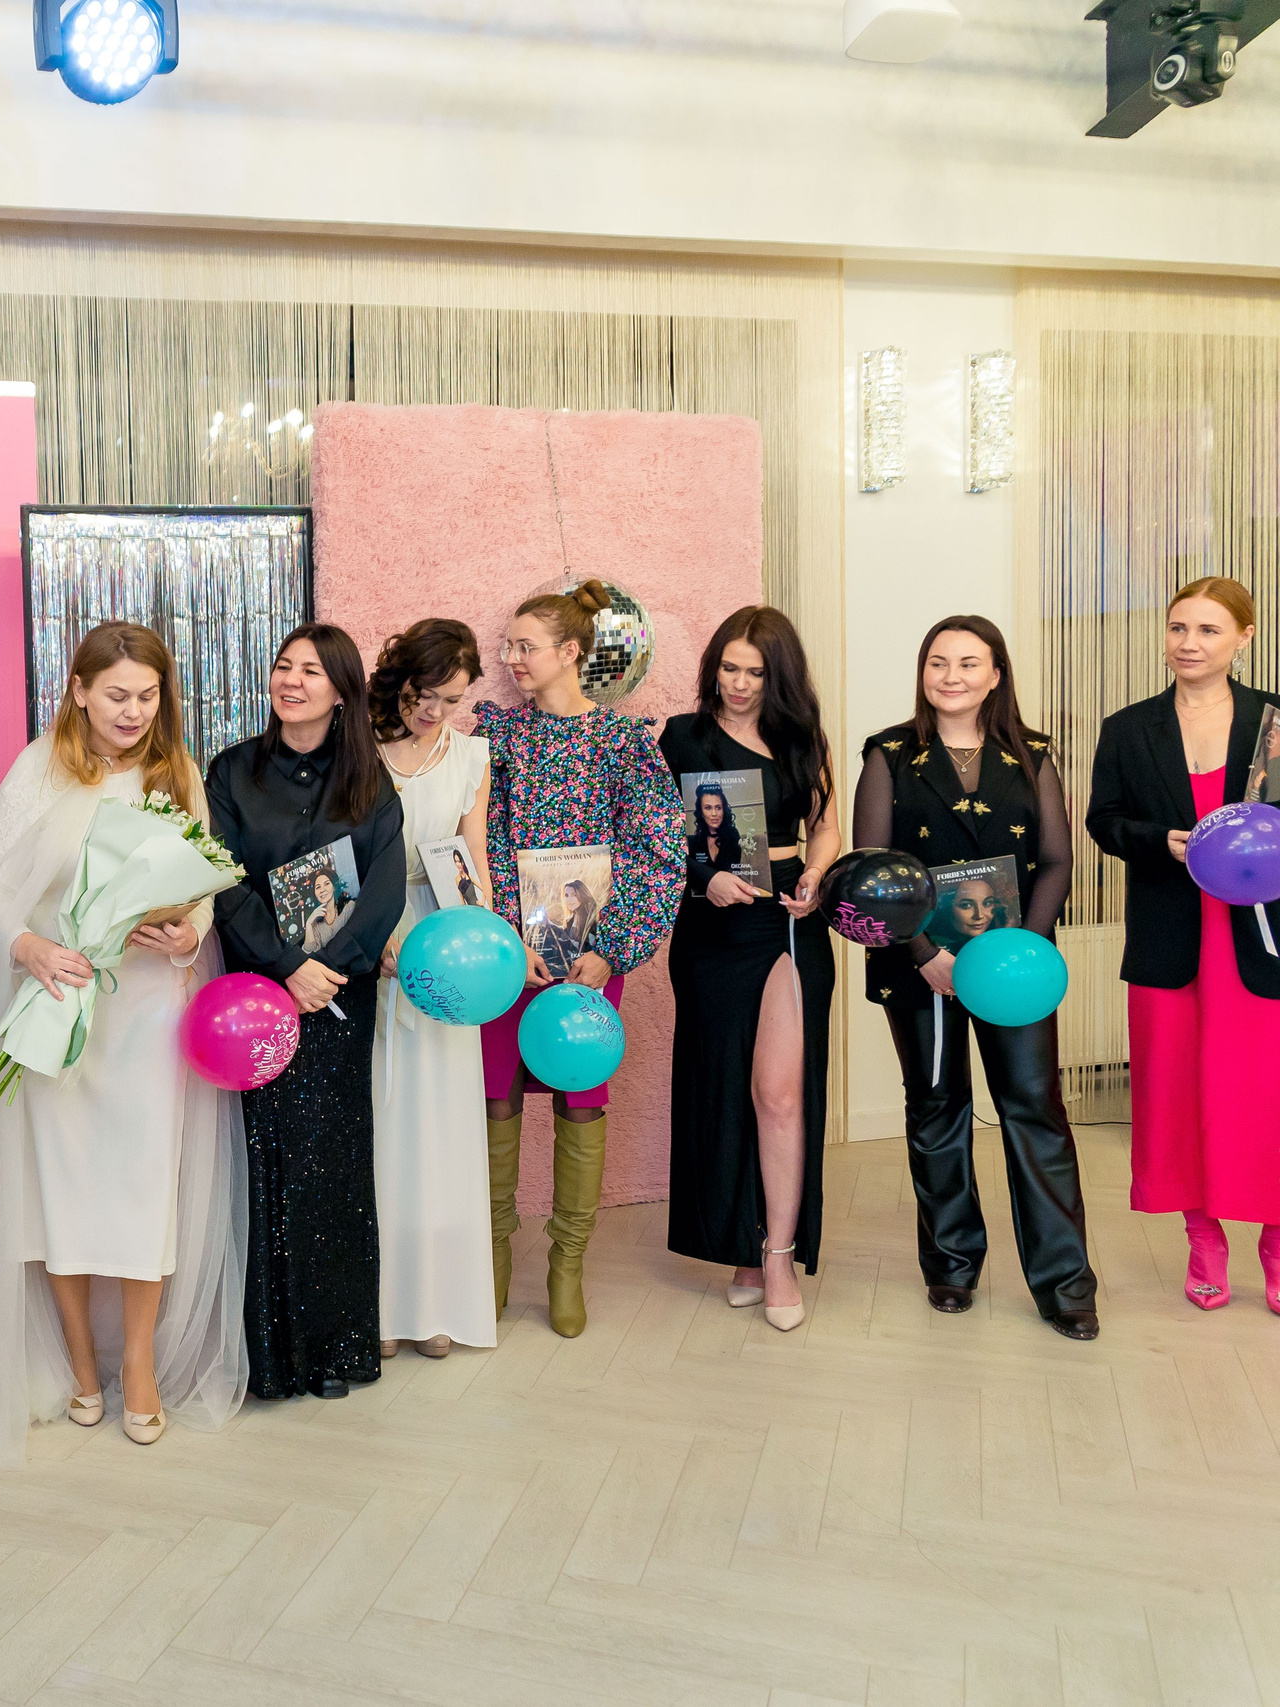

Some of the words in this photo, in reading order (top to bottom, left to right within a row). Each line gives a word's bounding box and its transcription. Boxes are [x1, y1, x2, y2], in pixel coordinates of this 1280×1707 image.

[535, 854, 562, 863] FORBES
[563, 852, 592, 860] WOMAN
[936, 870, 966, 881] FORBES
[966, 865, 997, 876] WOMAN
